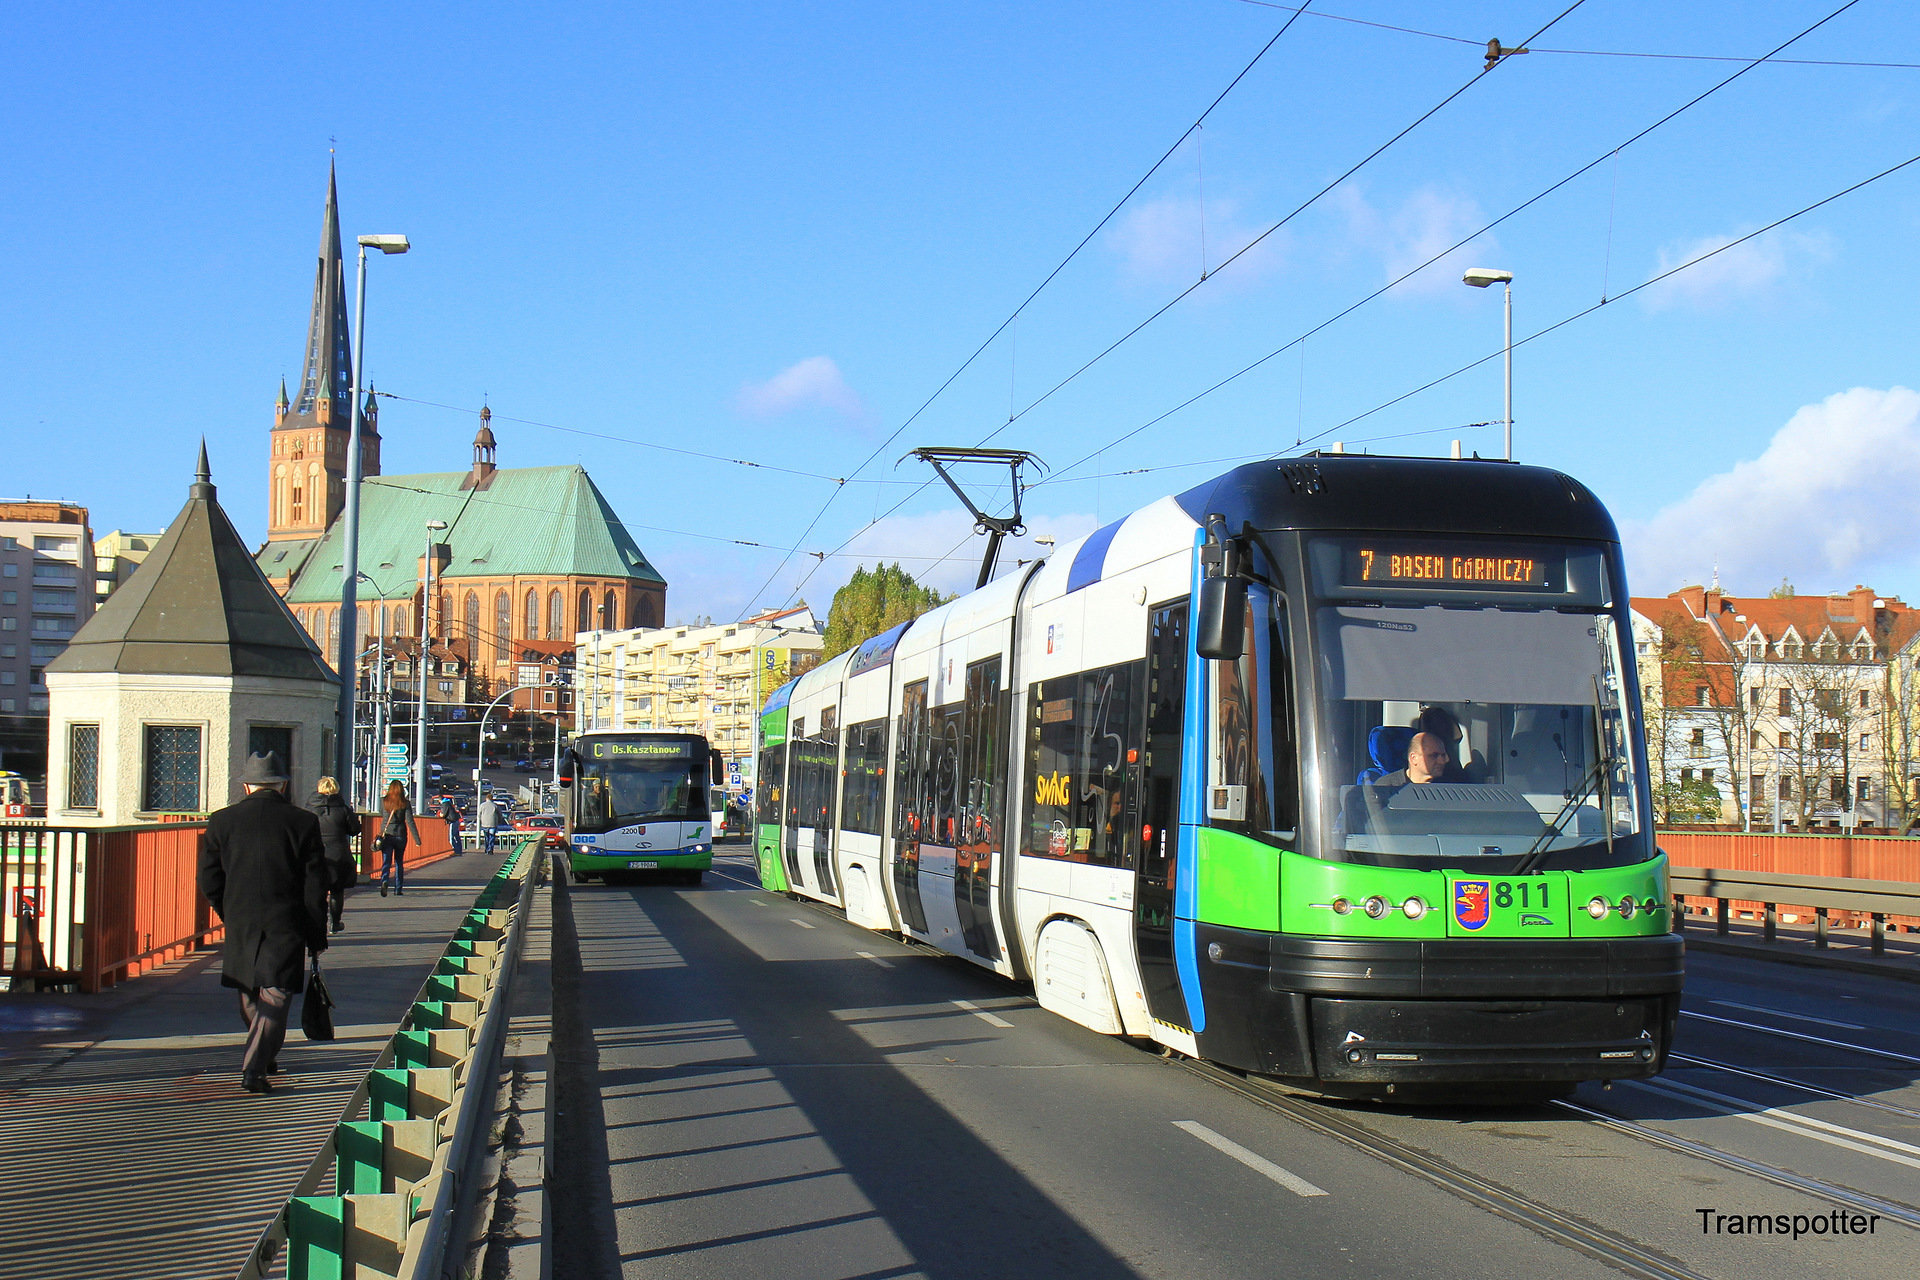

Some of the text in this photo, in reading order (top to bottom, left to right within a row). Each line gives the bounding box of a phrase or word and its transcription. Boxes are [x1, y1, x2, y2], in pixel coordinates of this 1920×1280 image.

[1361, 550, 1374, 581] 7
[1391, 554, 1444, 579] BASEN
[593, 743, 681, 758] C Os.Kasztanowe
[1495, 881, 1549, 908] 811
